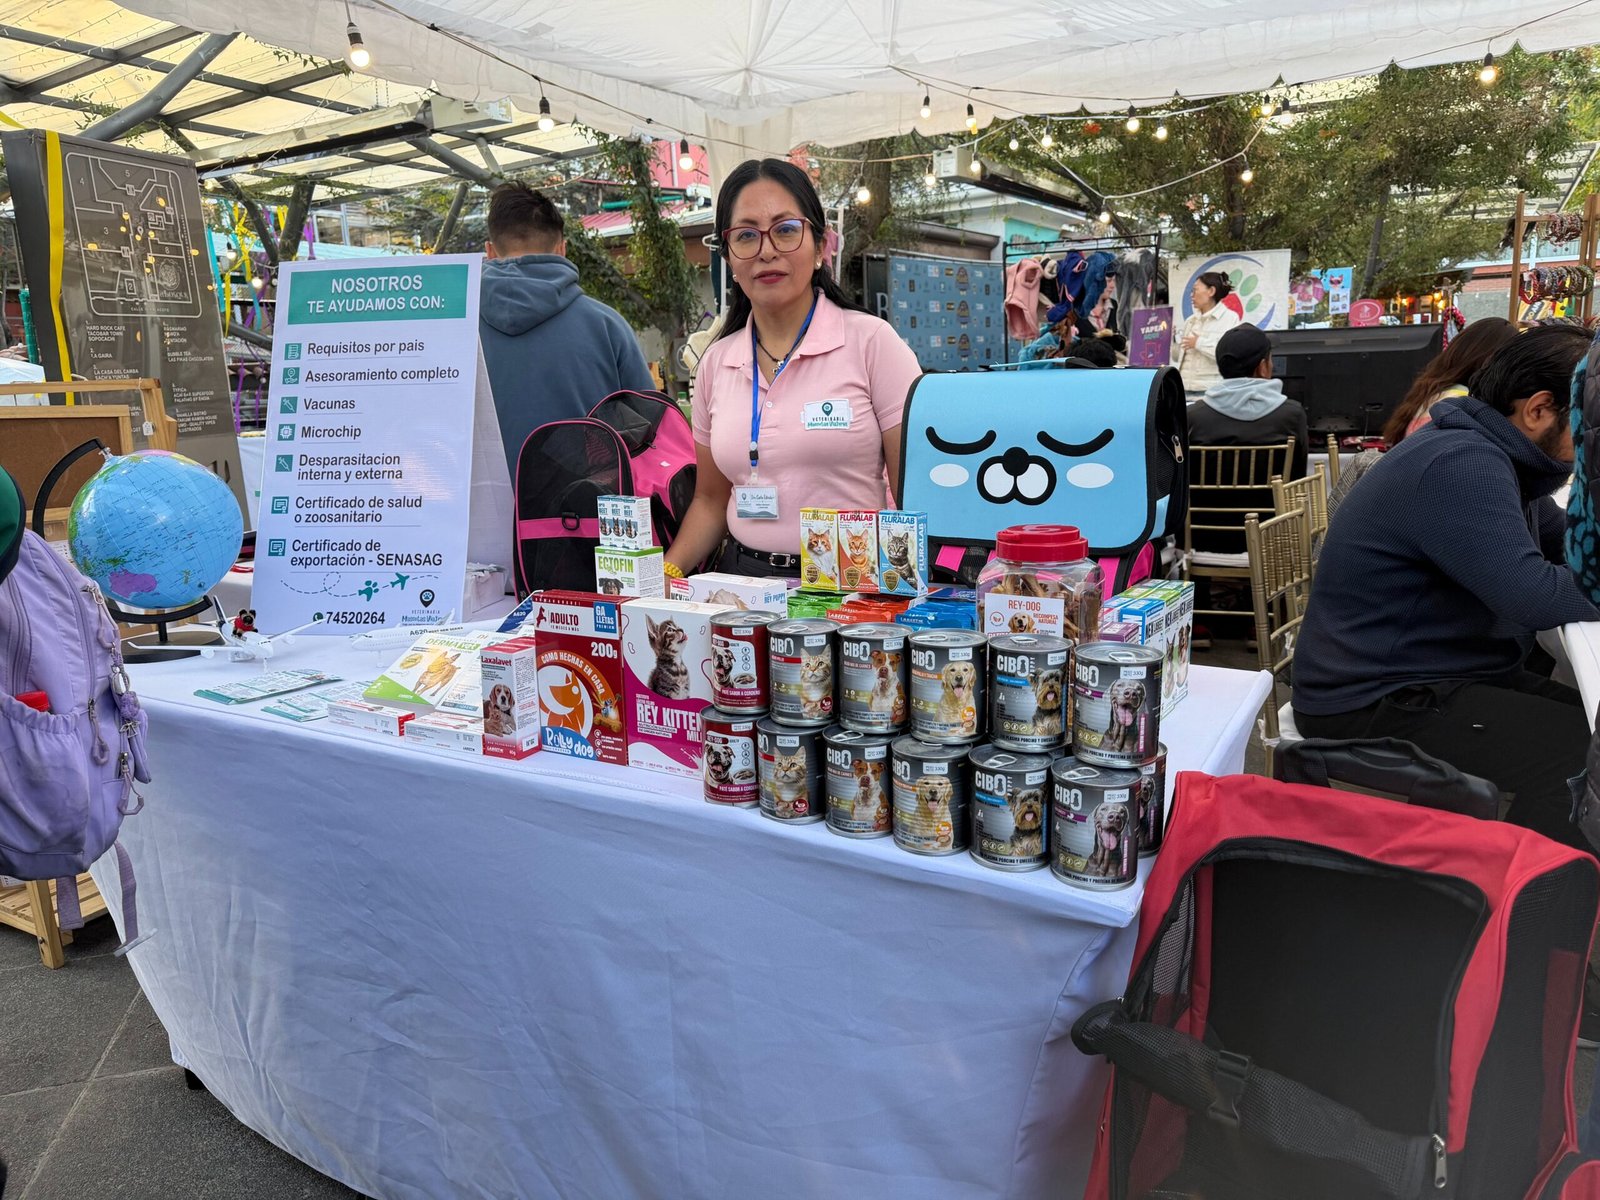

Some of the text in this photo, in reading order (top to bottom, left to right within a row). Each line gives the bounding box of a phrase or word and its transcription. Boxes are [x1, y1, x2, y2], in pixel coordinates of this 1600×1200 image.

[79, 177, 85, 185] 4
[125, 170, 130, 178] 5
[103, 227, 109, 235] 3
[128, 282, 134, 291] 2
[331, 274, 422, 294] NOSOTROS
[307, 296, 445, 313] TE AYUDAMOS CON:
[307, 341, 371, 356] Requisitos
[374, 341, 396, 354] por
[305, 366, 460, 382] Asesoramiento completo
[304, 398, 356, 410] Vacunas
[301, 425, 362, 440] Microchip
[299, 454, 400, 470] Desparasitacion
[297, 468, 403, 482] interna y externa
[295, 495, 422, 509] Certificado de salud
[294, 511, 382, 523] o zoosanitario
[802, 513, 834, 521] FLURALAB
[840, 513, 874, 522] FLURALAB
[881, 515, 915, 525] FLURALAB
[292, 539, 381, 552] Certificado de
[290, 554, 365, 569] exportación
[377, 553, 442, 566] SENASAG
[598, 556, 634, 573] ECTOFIN
[596, 606, 606, 616] GA
[1008, 600, 1040, 611] REY-DOG
[325, 611, 385, 624] 74520264
[550, 612, 579, 626] ADULTO
[596, 616, 614, 625] LLETAS
[591, 642, 618, 658] 200g
[770, 636, 794, 656] CIBO
[844, 641, 870, 661] CIBO
[481, 656, 512, 666] Laxalavet
[912, 649, 935, 671] CIBO
[997, 655, 1029, 677] CIBO
[541, 652, 605, 694] COMO HECHAS EN CASA
[1075, 663, 1099, 687] CIBO
[637, 703, 658, 724] REY
[687, 730, 702, 742] MIL
[574, 741, 594, 758] dog
[827, 748, 851, 769] CIBO
[975, 770, 1006, 796] CIBO
[1054, 783, 1082, 811] CIBO
